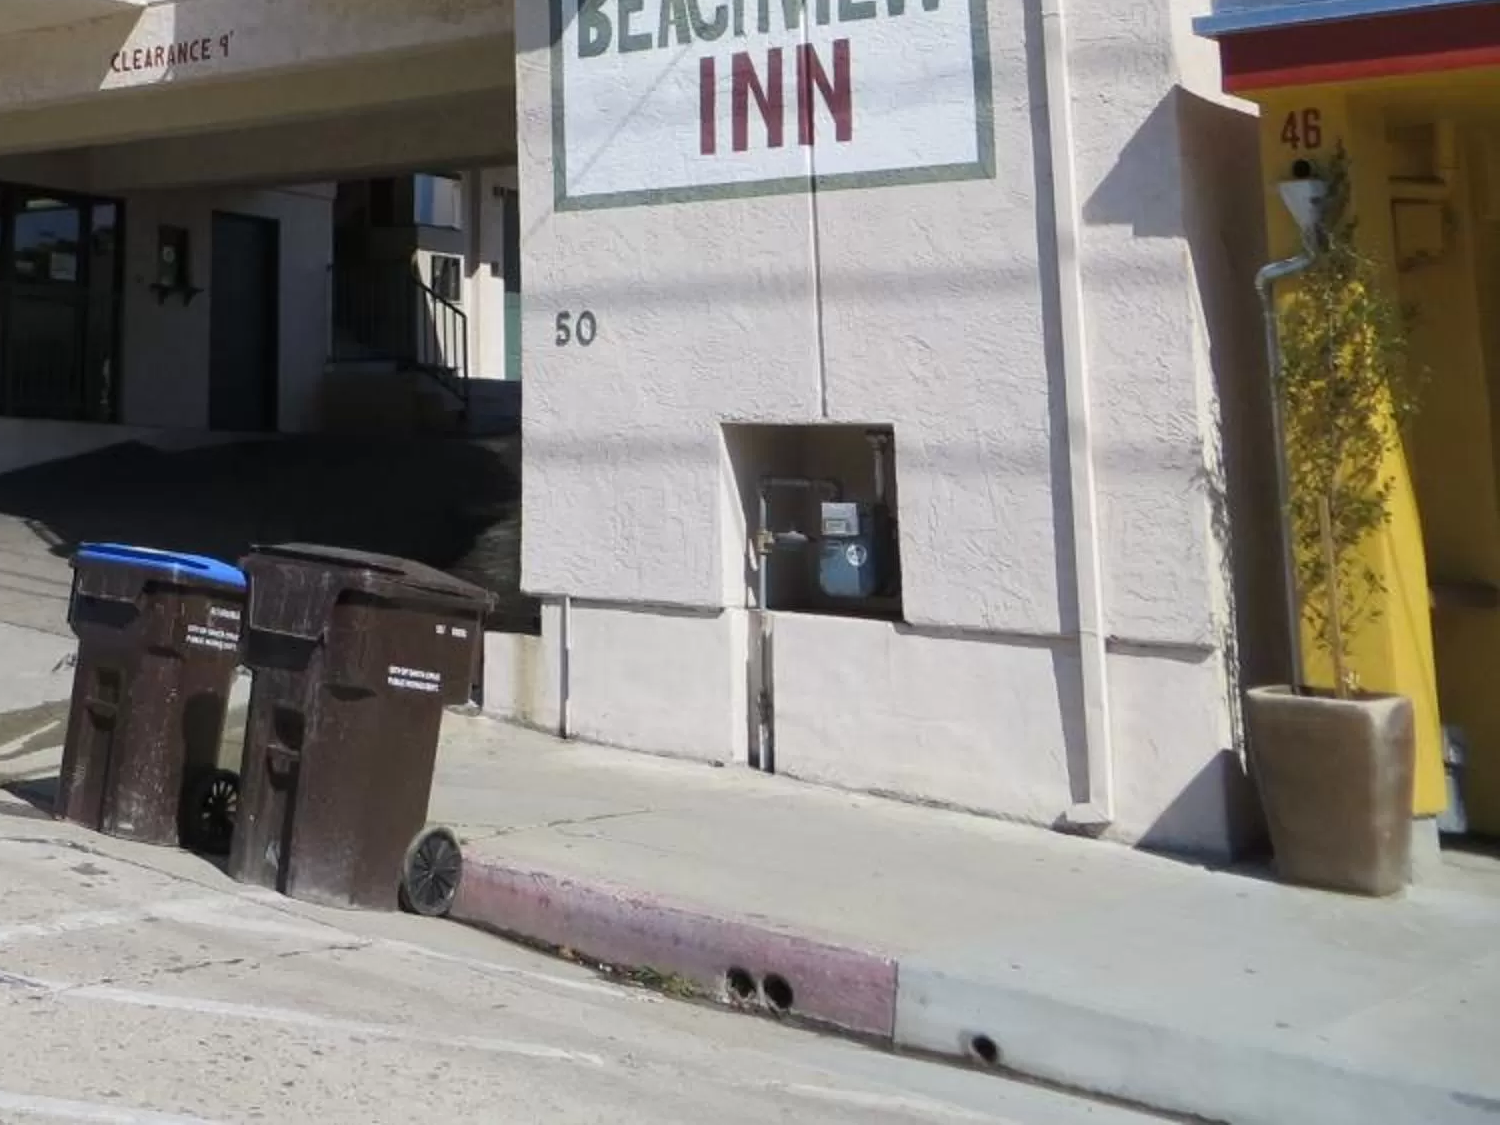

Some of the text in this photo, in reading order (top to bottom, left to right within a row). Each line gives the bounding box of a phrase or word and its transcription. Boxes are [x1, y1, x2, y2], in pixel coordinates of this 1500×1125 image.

[111, 38, 211, 72] CLEARANCE
[698, 38, 853, 156] INN
[1280, 108, 1321, 149] 46
[555, 311, 597, 347] 50
